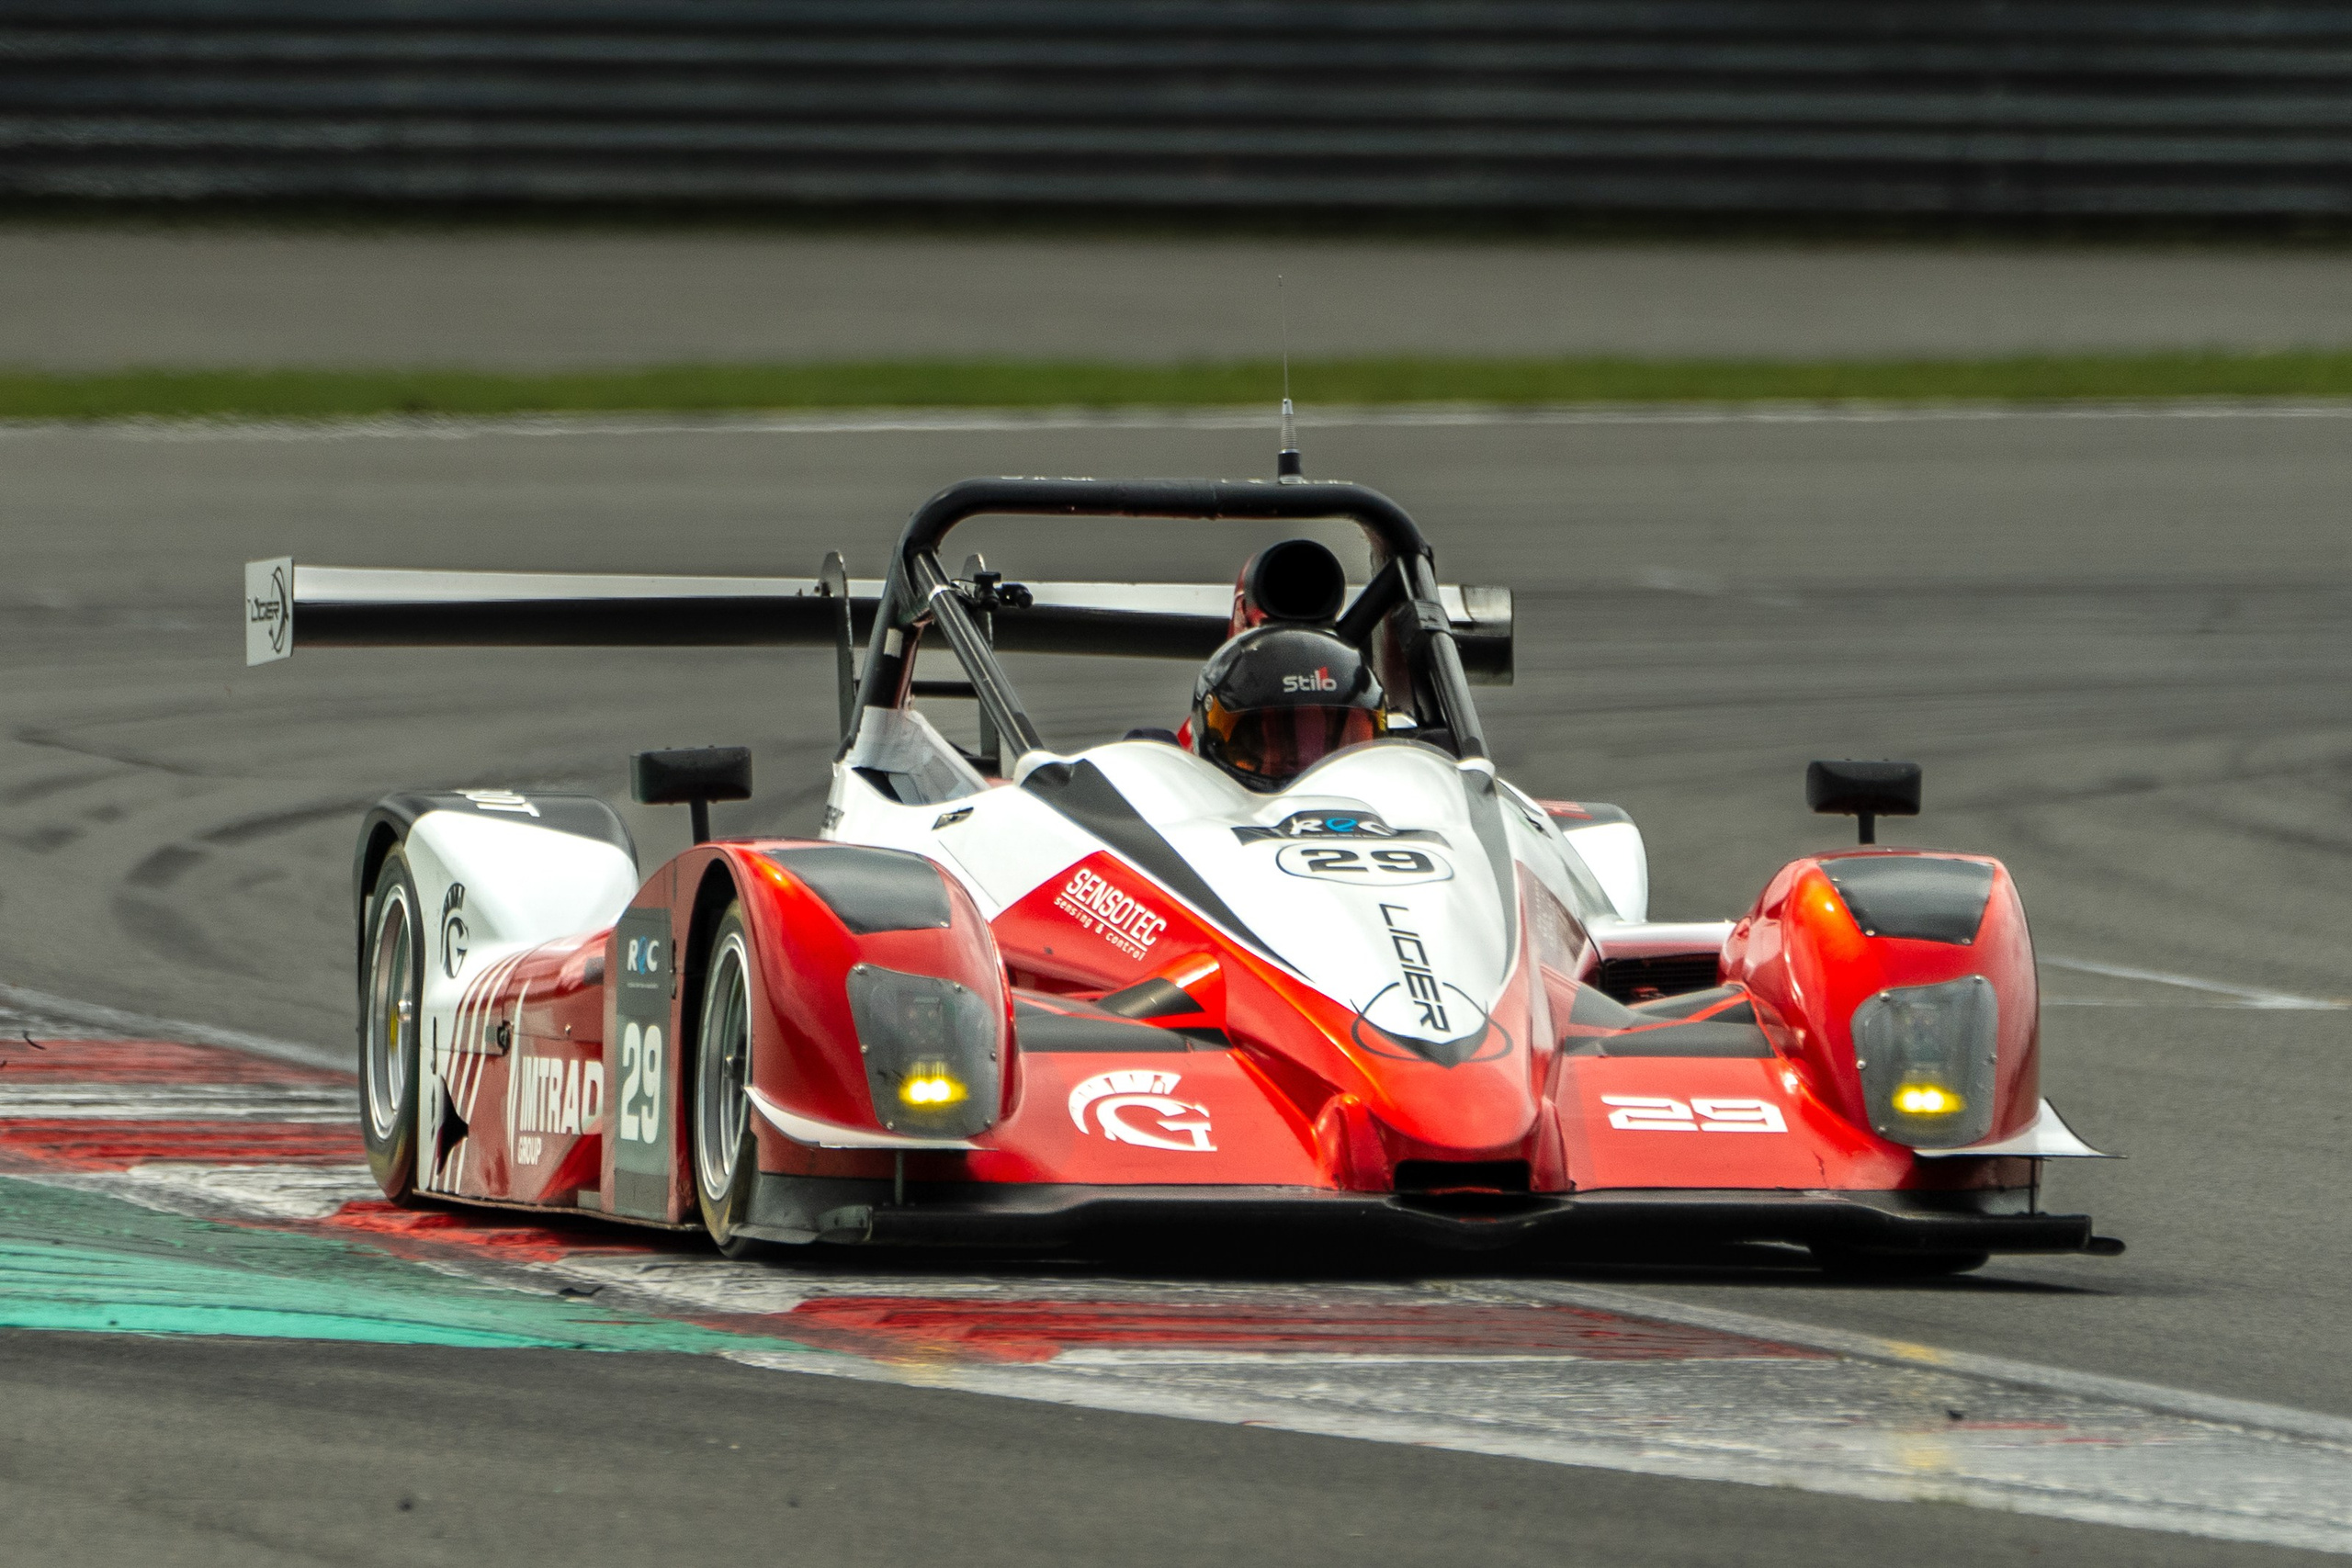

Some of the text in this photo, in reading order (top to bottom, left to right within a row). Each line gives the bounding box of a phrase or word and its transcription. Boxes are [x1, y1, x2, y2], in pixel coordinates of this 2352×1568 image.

[1283, 666, 1338, 694] Stilo
[1301, 849, 1435, 874] 29
[1054, 897, 1147, 962] sensing & control
[1066, 868, 1167, 946] SENSOTEC
[1378, 903, 1452, 1032] LIGIER
[620, 1022, 662, 1145] 29
[1600, 1096, 1789, 1133] 29
[517, 1136, 542, 1166] GROUP
